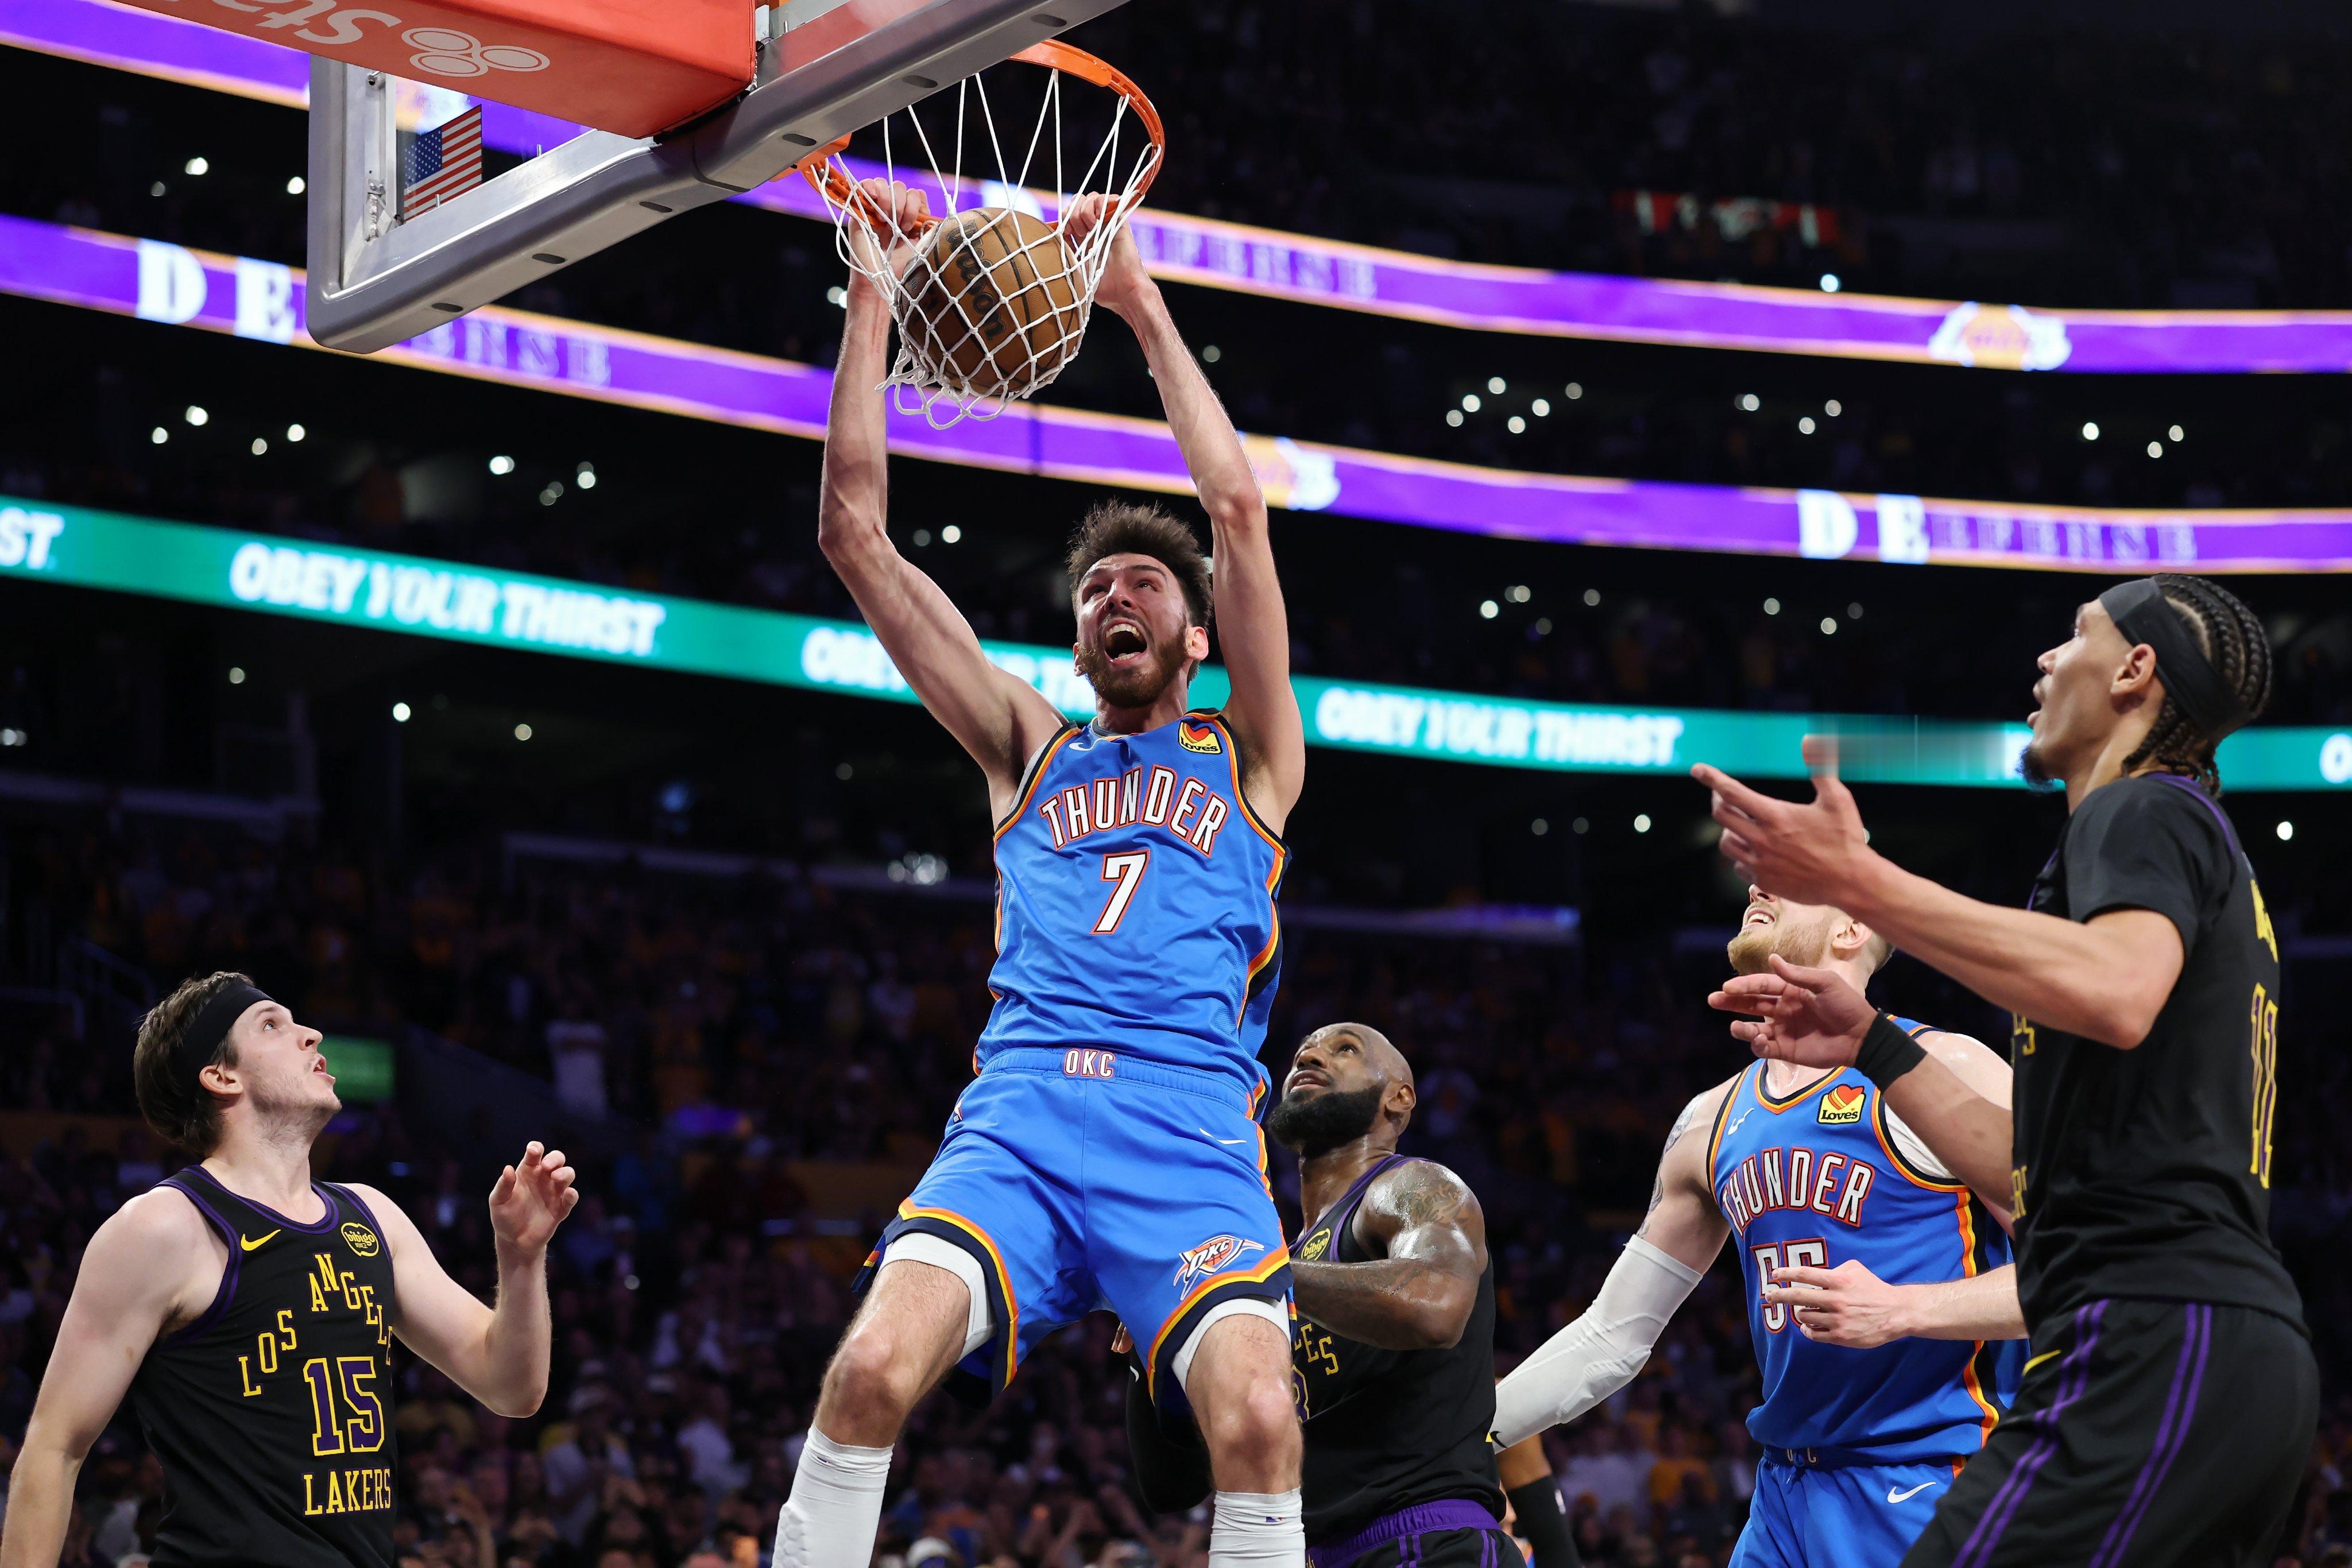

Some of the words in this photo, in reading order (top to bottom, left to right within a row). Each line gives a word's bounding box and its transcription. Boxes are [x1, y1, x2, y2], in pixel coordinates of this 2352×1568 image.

[230, 543, 366, 612] OBEY
[501, 582, 666, 655] THIRST
[1534, 710, 1683, 766] THIRST
[1038, 764, 1231, 859] THUNDER
[1089, 848, 1151, 936] 7
[1063, 1048, 1117, 1079] OKC
[343, 1230, 376, 1246] bibigo
[1722, 1147, 1875, 1241] THUNDER
[1185, 1239, 1230, 1278] OKC
[238, 1309, 297, 1397] LOS
[303, 1356, 385, 1457] 15
[303, 1468, 391, 1516] LAKERS
